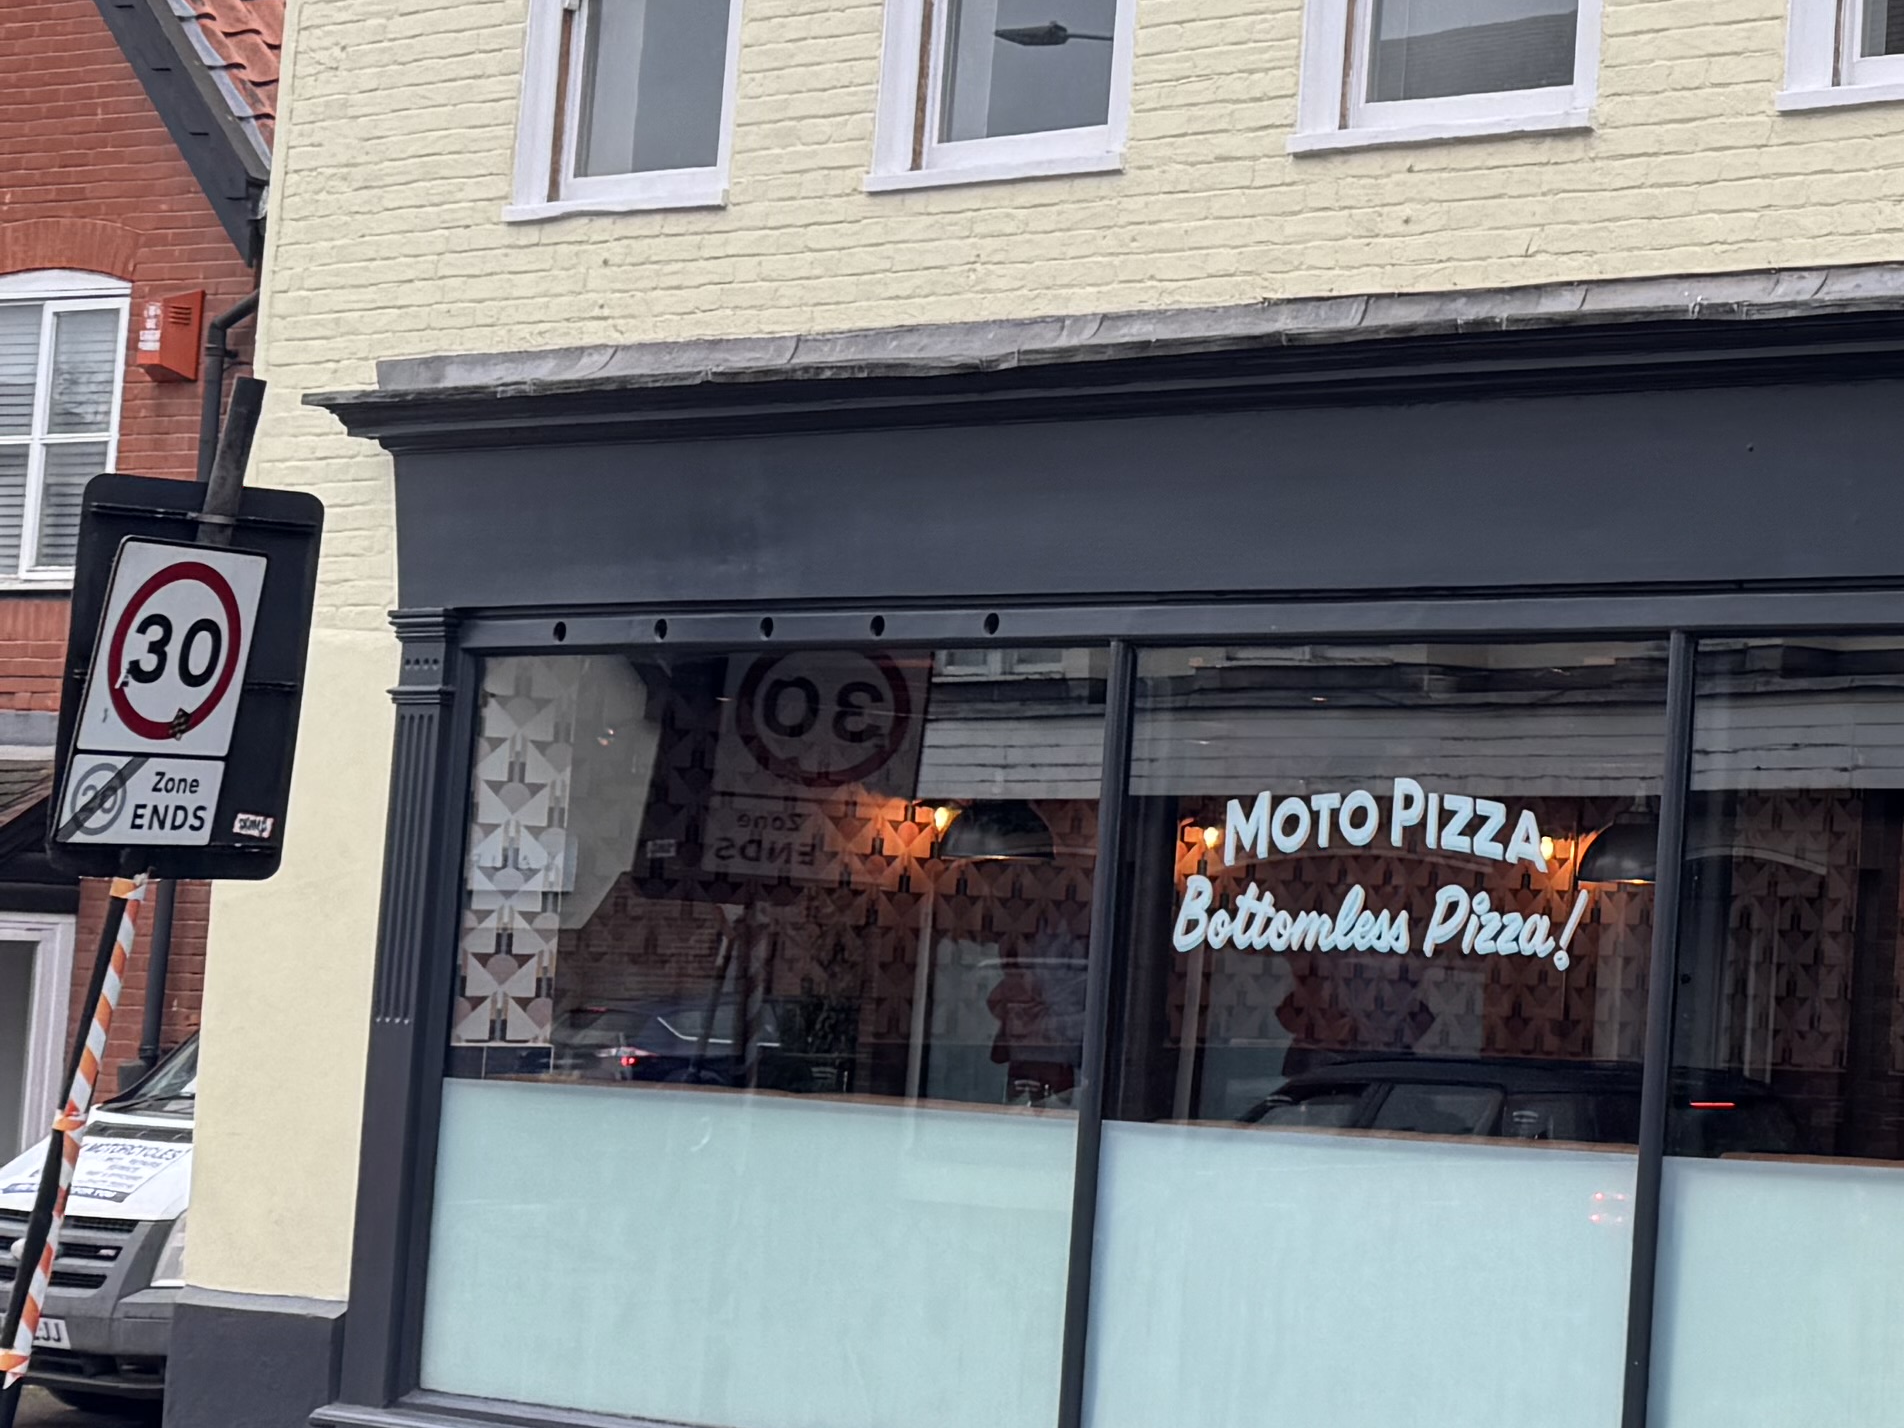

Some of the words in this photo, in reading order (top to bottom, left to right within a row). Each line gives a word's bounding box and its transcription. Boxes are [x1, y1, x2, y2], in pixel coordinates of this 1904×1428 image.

[127, 613, 222, 688] 30
[130, 804, 207, 831] ENDS
[152, 771, 199, 794] Zone
[1223, 789, 1379, 866] MOTO
[1391, 777, 1548, 873] PIZZA
[1173, 875, 1410, 954] Bottomless
[1422, 883, 1589, 971] Pizza!
